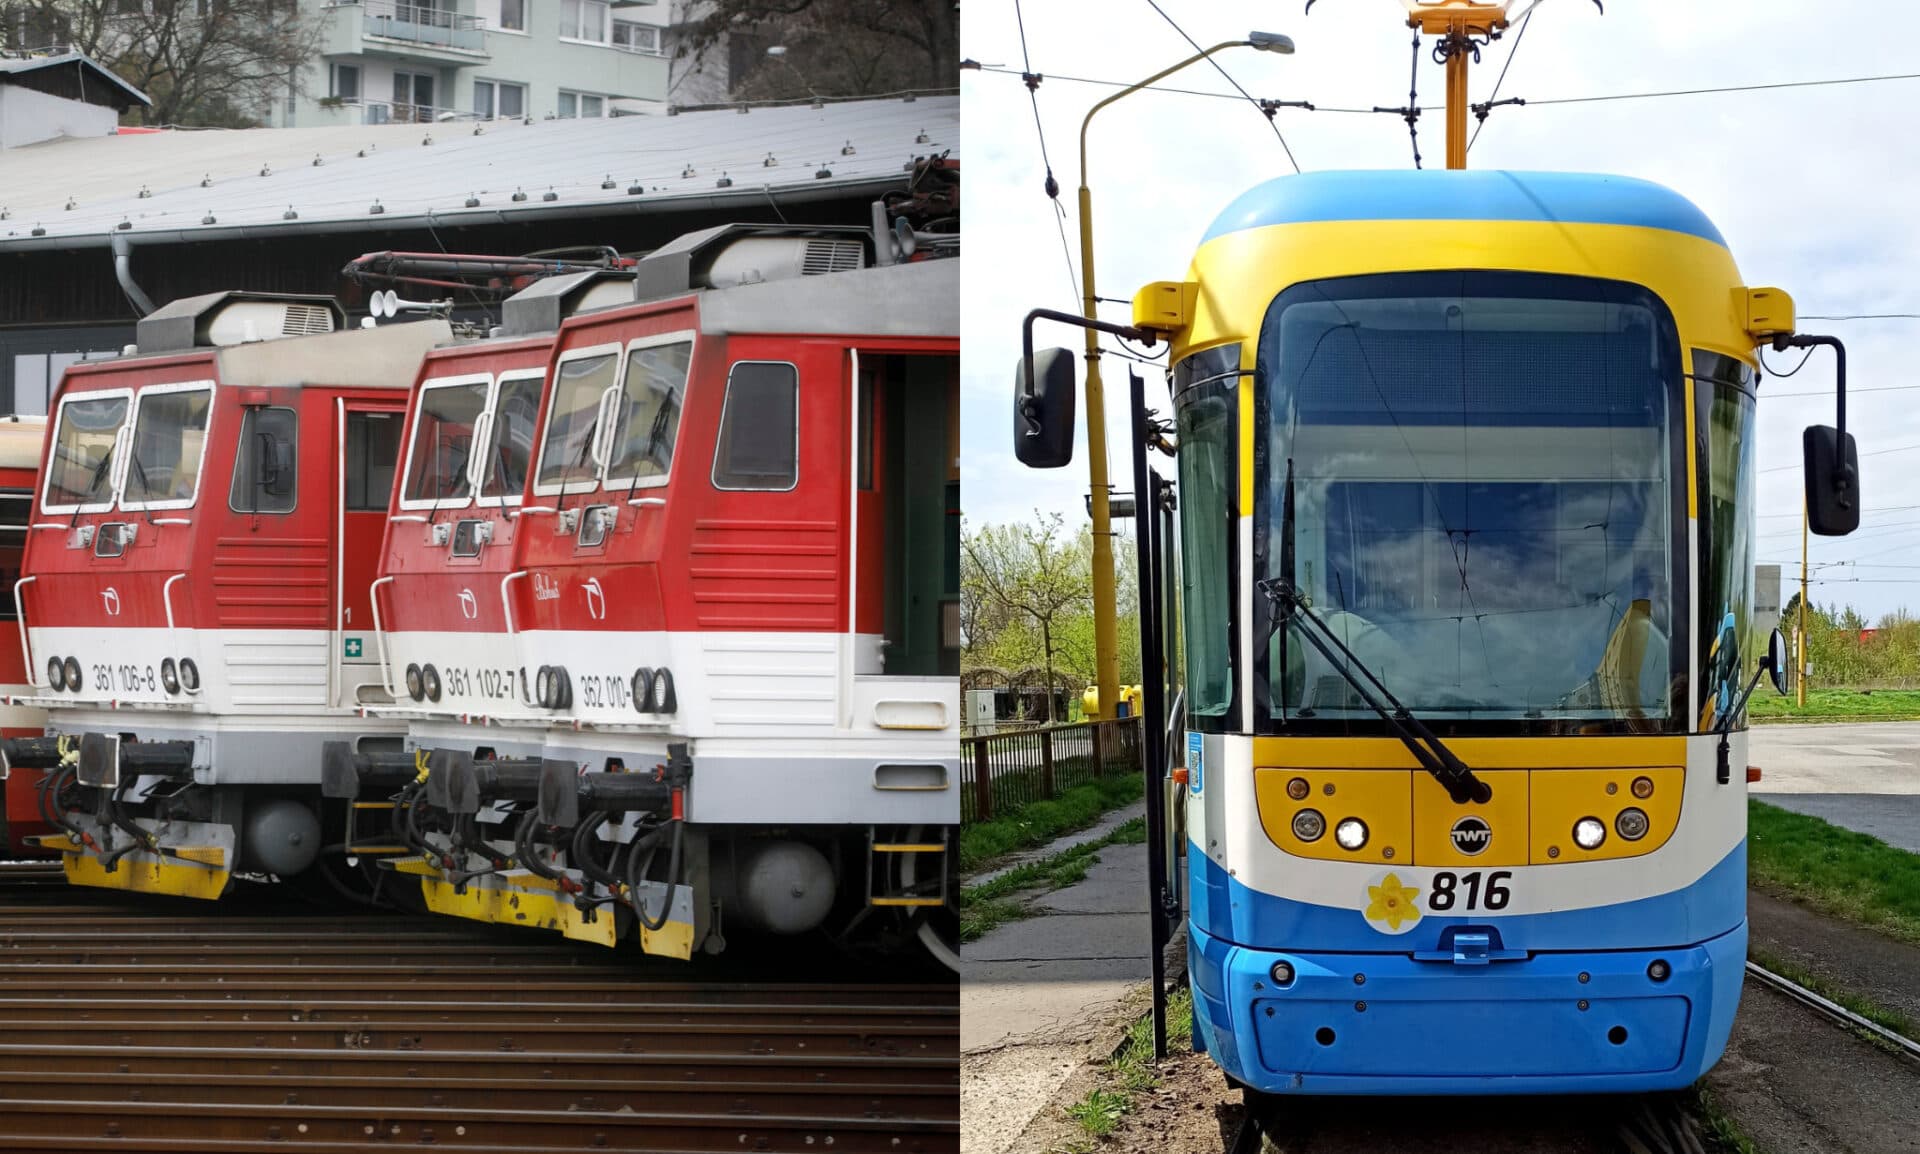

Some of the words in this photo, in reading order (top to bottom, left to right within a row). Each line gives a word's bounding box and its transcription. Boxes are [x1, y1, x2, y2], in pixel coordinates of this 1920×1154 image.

[344, 607, 352, 624] 1
[93, 664, 115, 691] 361
[119, 664, 156, 692] 106-8
[446, 668, 472, 696] 361
[476, 668, 515, 699] 102-7
[581, 676, 604, 708] 362
[606, 676, 633, 708] 010-
[1451, 830, 1491, 841] TWT
[1429, 871, 1512, 910] 816
